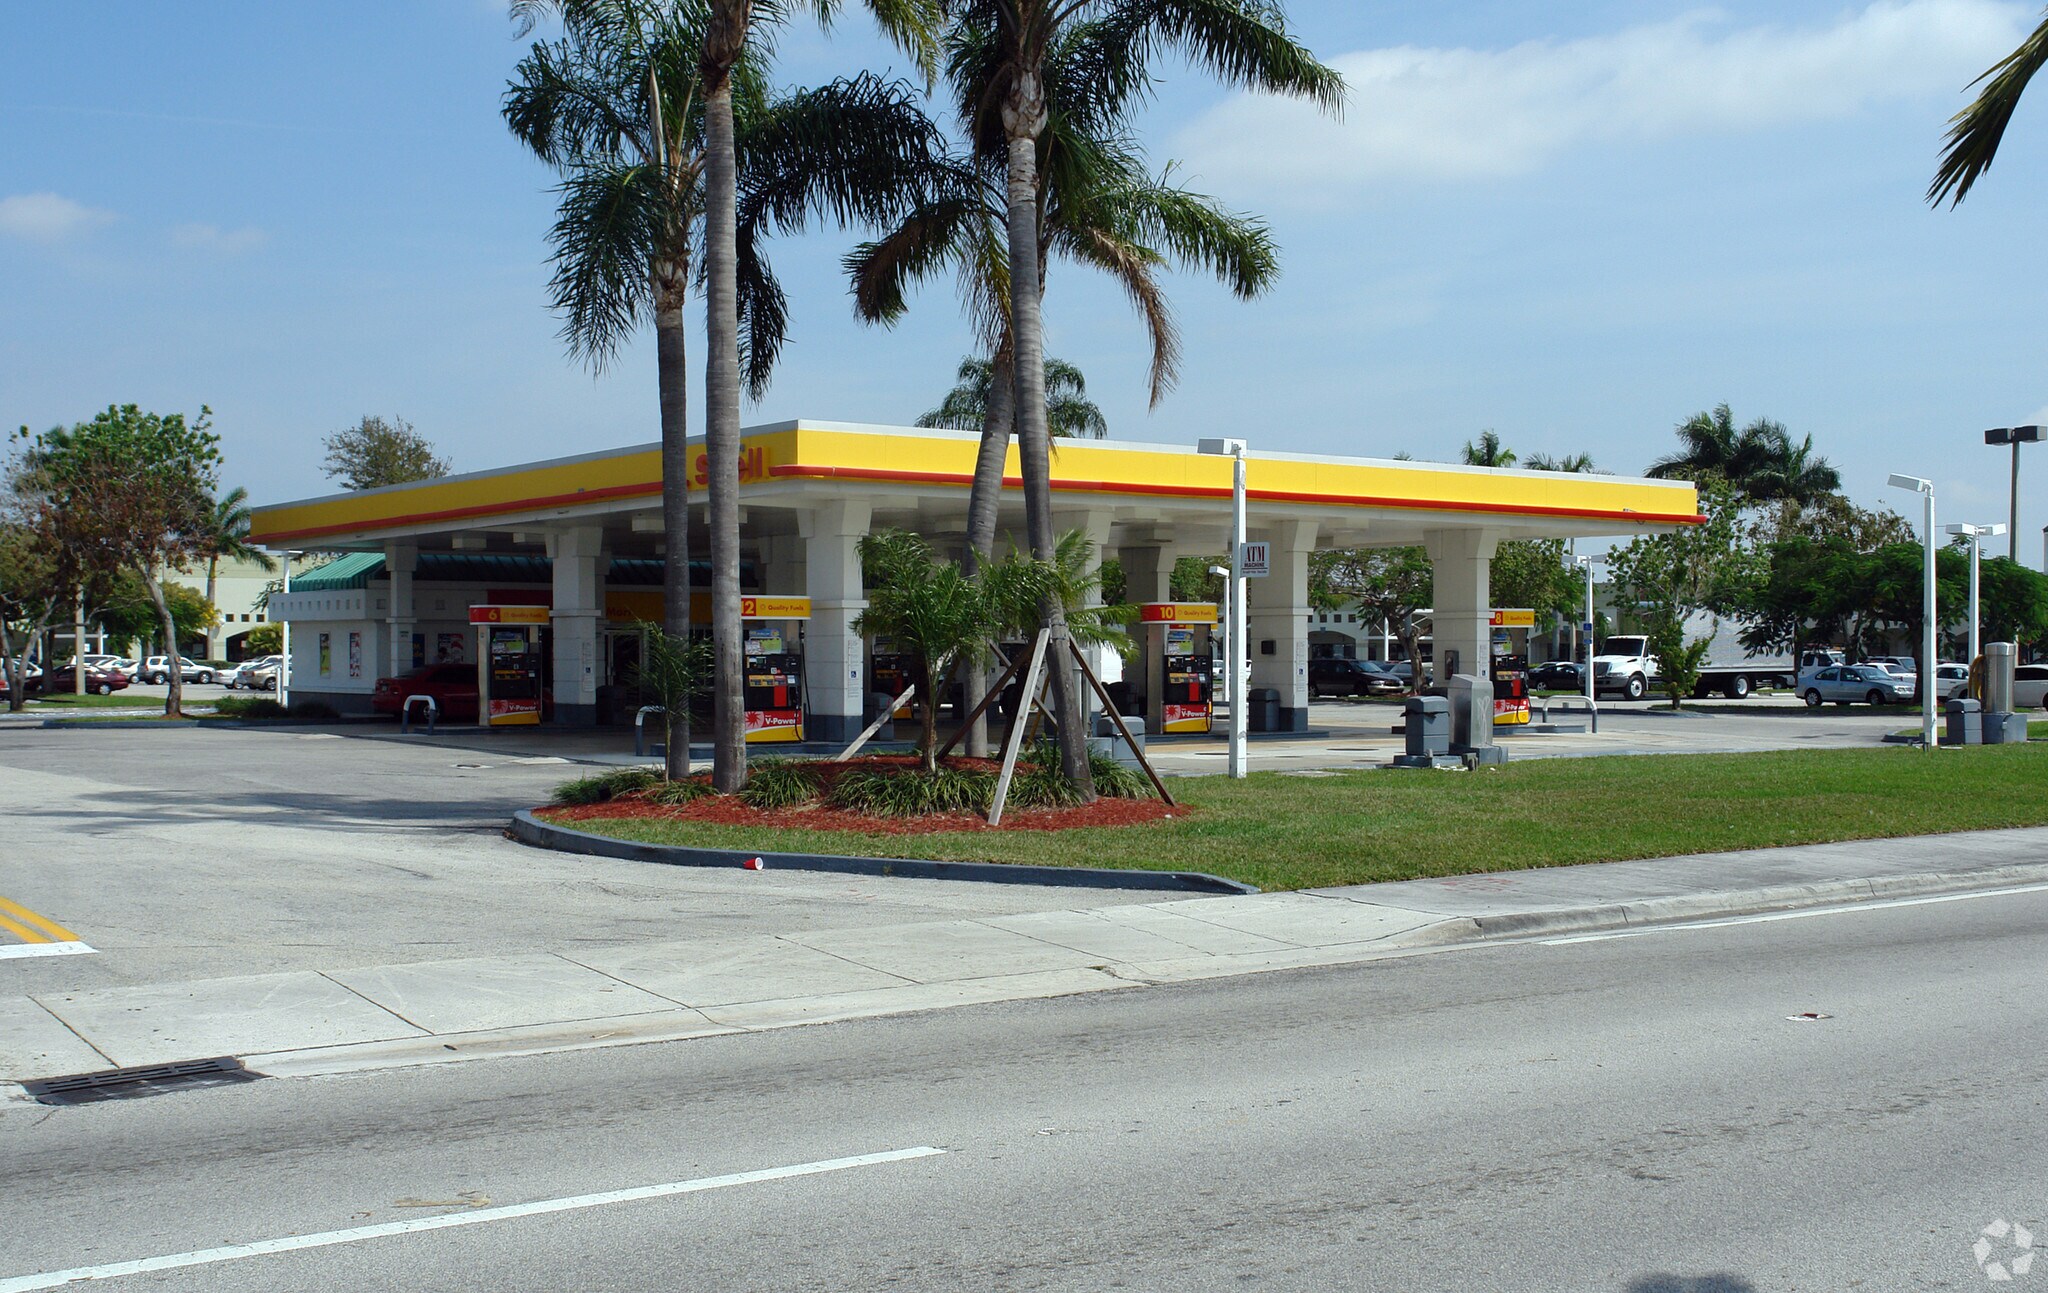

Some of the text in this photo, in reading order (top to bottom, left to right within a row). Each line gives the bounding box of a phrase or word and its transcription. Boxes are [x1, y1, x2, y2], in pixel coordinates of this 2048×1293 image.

[695, 447, 762, 485] Sll
[1245, 546, 1264, 562] ATM
[488, 609, 498, 620] 6
[1160, 607, 1173, 619] 10
[1495, 613, 1501, 624] 8
